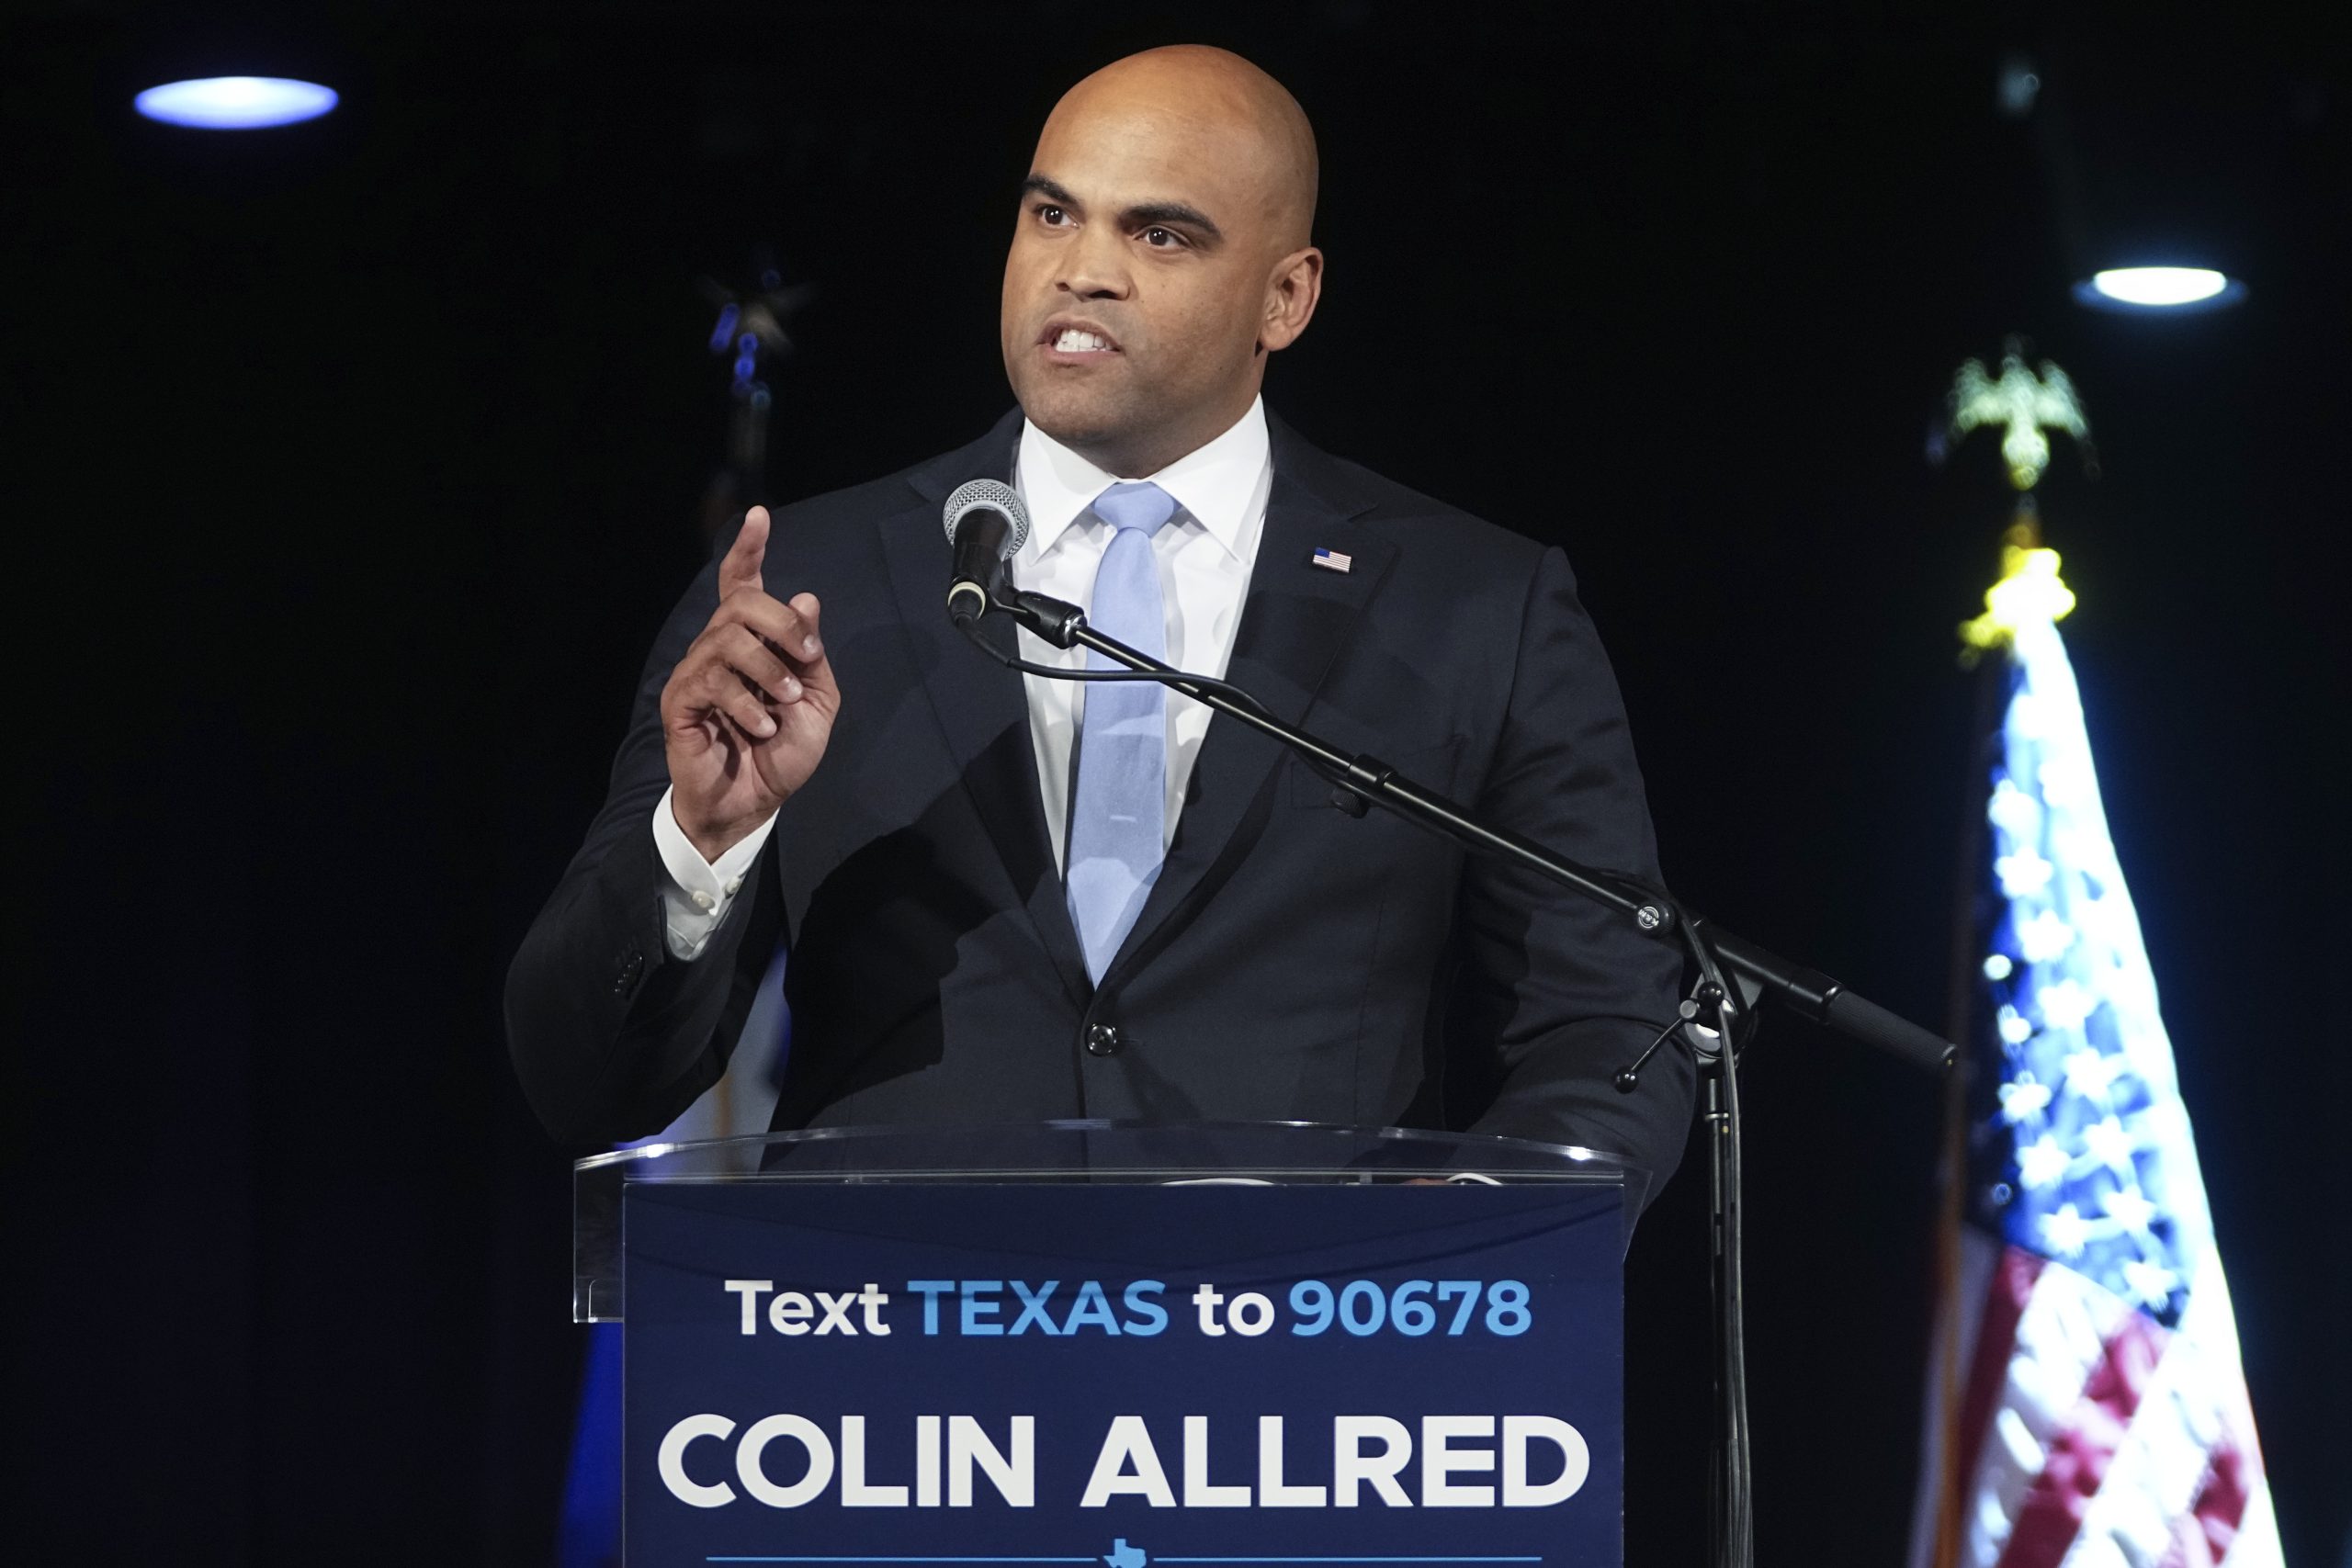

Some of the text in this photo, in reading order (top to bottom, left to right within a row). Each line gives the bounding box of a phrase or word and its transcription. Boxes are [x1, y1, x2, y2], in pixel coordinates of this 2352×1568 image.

[725, 1280, 1532, 1337] Text TEXAS to 90678
[658, 1414, 1589, 1508] COLIN ALLRED
